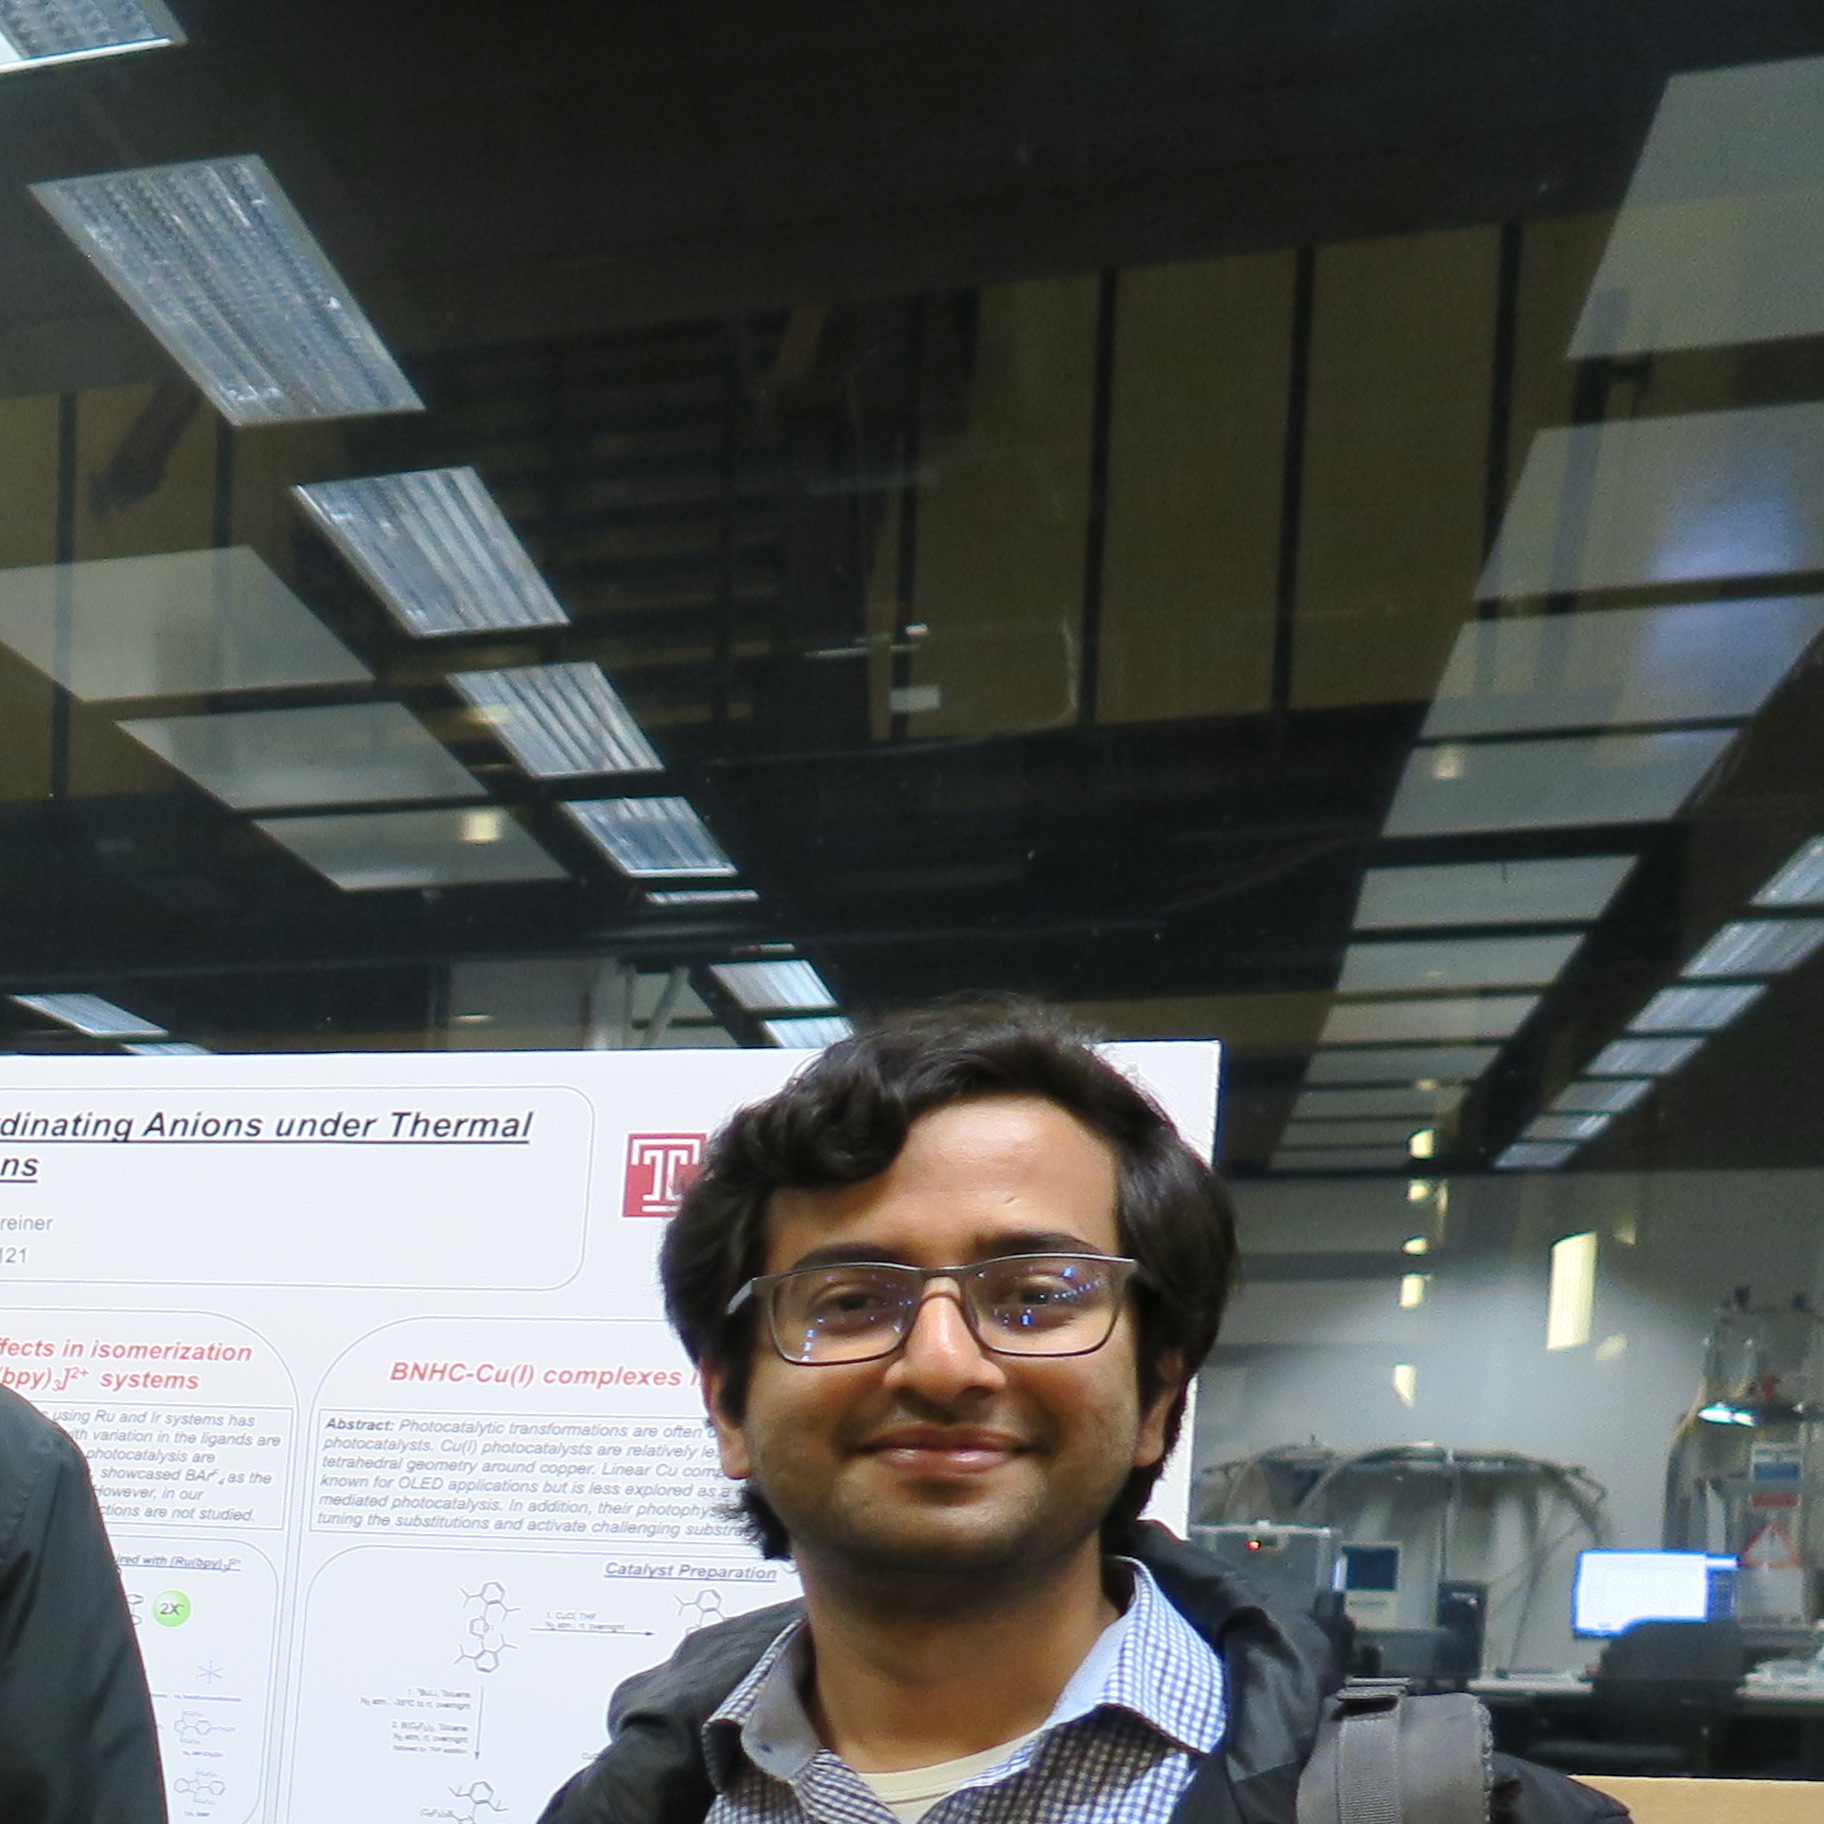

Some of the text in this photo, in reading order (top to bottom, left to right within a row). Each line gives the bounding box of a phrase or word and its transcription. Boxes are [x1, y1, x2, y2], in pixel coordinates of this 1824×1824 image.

[142, 1111, 262, 1138] Anions
[275, 1112, 377, 1138] under
[391, 1111, 533, 1137] Thermal
[62, 1340, 83, 1357] in
[90, 1340, 252, 1360] isomerization
[100, 1372, 198, 1391] systems
[390, 1361, 682, 1389] BNHC-Cu(I) complexes
[94, 1410, 115, 1422] Ru
[118, 1411, 148, 1423] and
[164, 1413, 224, 1426] systems
[227, 1414, 255, 1427] has
[324, 1417, 704, 1437] Abstract: Photocatalytic transformations are often
[93, 1430, 281, 1446] variation in the ligands are
[192, 1453, 215, 1463] are
[480, 1440, 592, 1458] photocatalysts
[596, 1445, 622, 1456] are
[626, 1443, 698, 1460] relatively
[322, 1455, 403, 1469] tetrahedral
[406, 1459, 478, 1475] geometry
[481, 1460, 536, 1473] around
[601, 1462, 652, 1476] Linear
[320, 1474, 369, 1487] known
[372, 1475, 394, 1488] for
[398, 1475, 443, 1490] OLED
[447, 1478, 538, 1493] applications
[542, 1480, 568, 1493] but
[588, 1481, 620, 1495] less
[624, 1483, 693, 1498] explored
[318, 1493, 389, 1507] mediated
[317, 1512, 680, 1538] tuning the substitutions and activate challenging
[605, 1562, 778, 1580] Catalyst Preparation
